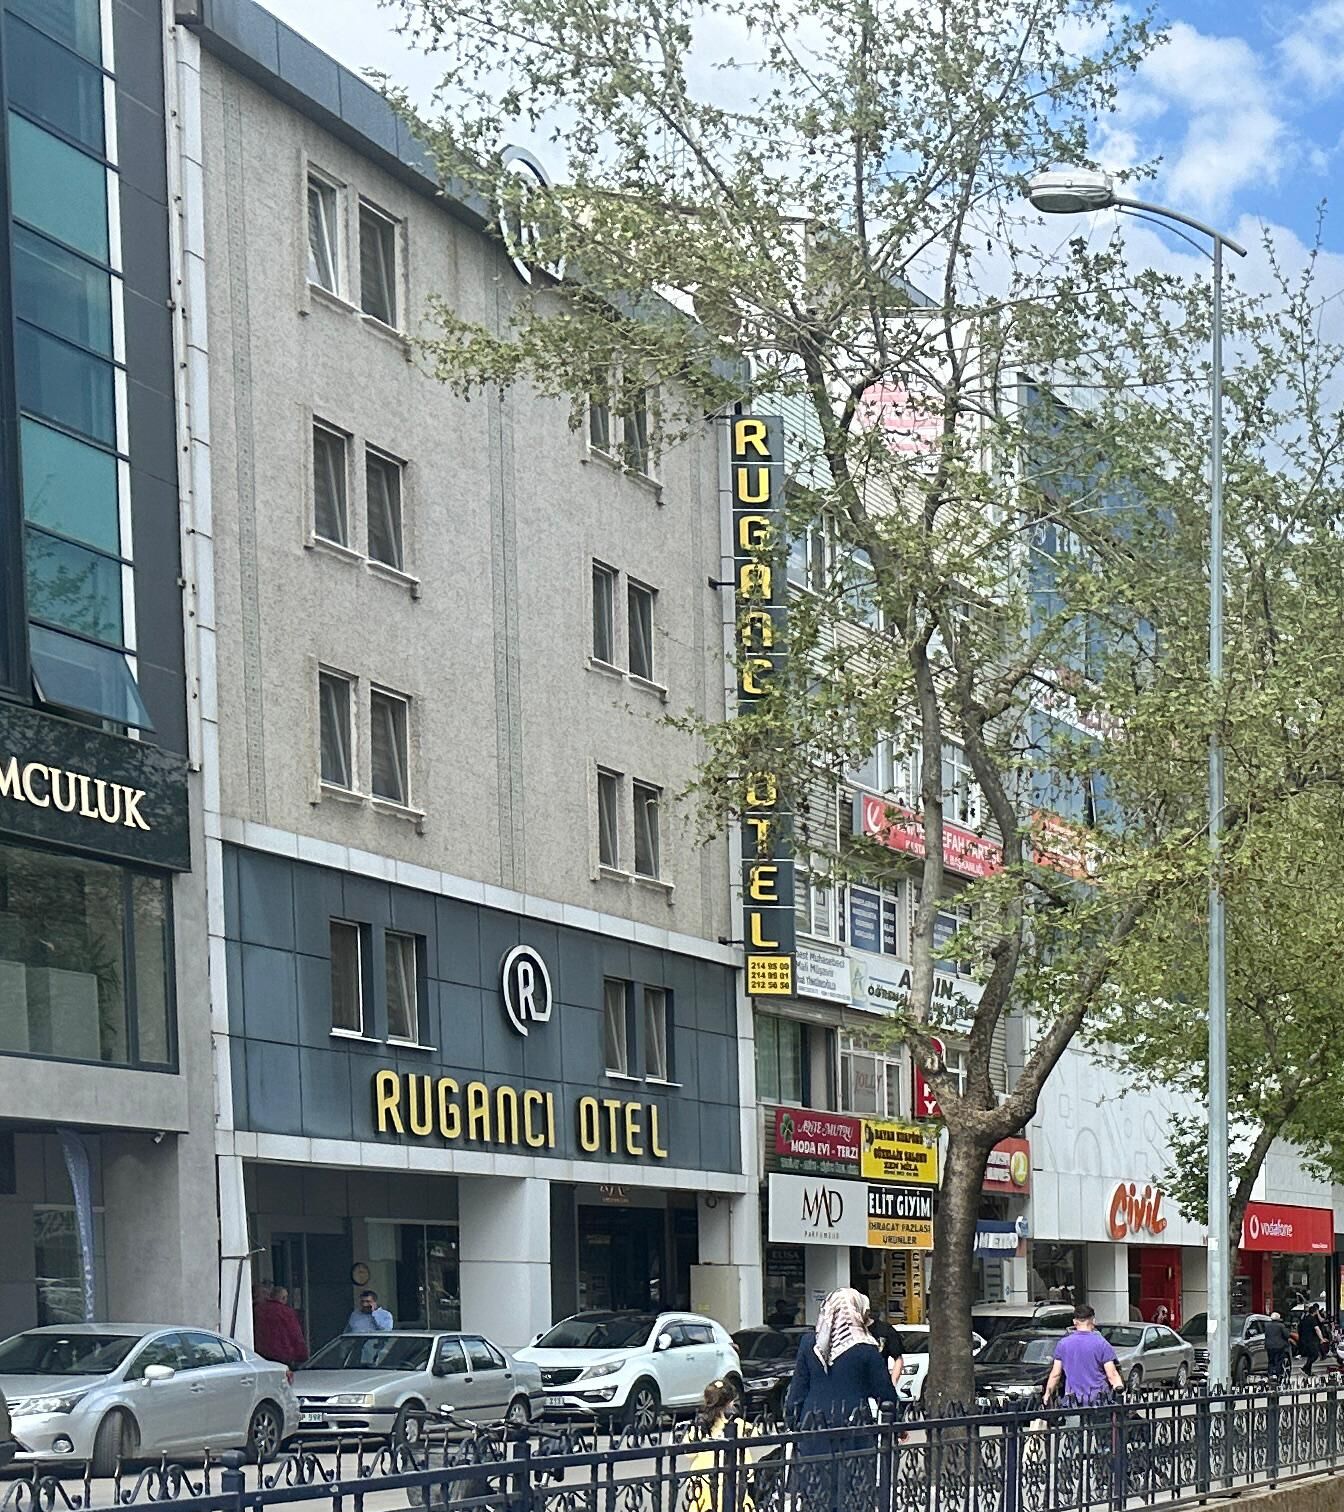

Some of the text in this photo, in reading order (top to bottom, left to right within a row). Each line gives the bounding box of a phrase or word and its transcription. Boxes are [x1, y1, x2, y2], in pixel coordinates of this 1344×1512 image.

[735, 418, 775, 694] RUGANC
[745, 770, 780, 948] OTEL
[375, 1069, 668, 1158] RUGANCI OTEL
[790, 1139, 816, 1154] MODA
[836, 1143, 859, 1159] TERZİ
[801, 1184, 844, 1228] MAD
[868, 1187, 931, 1218] ELİT GİYİM
[1261, 1217, 1293, 1238] vodafone
[892, 1251, 906, 1297] UTLET
[912, 1252, 921, 1297] UTLET
